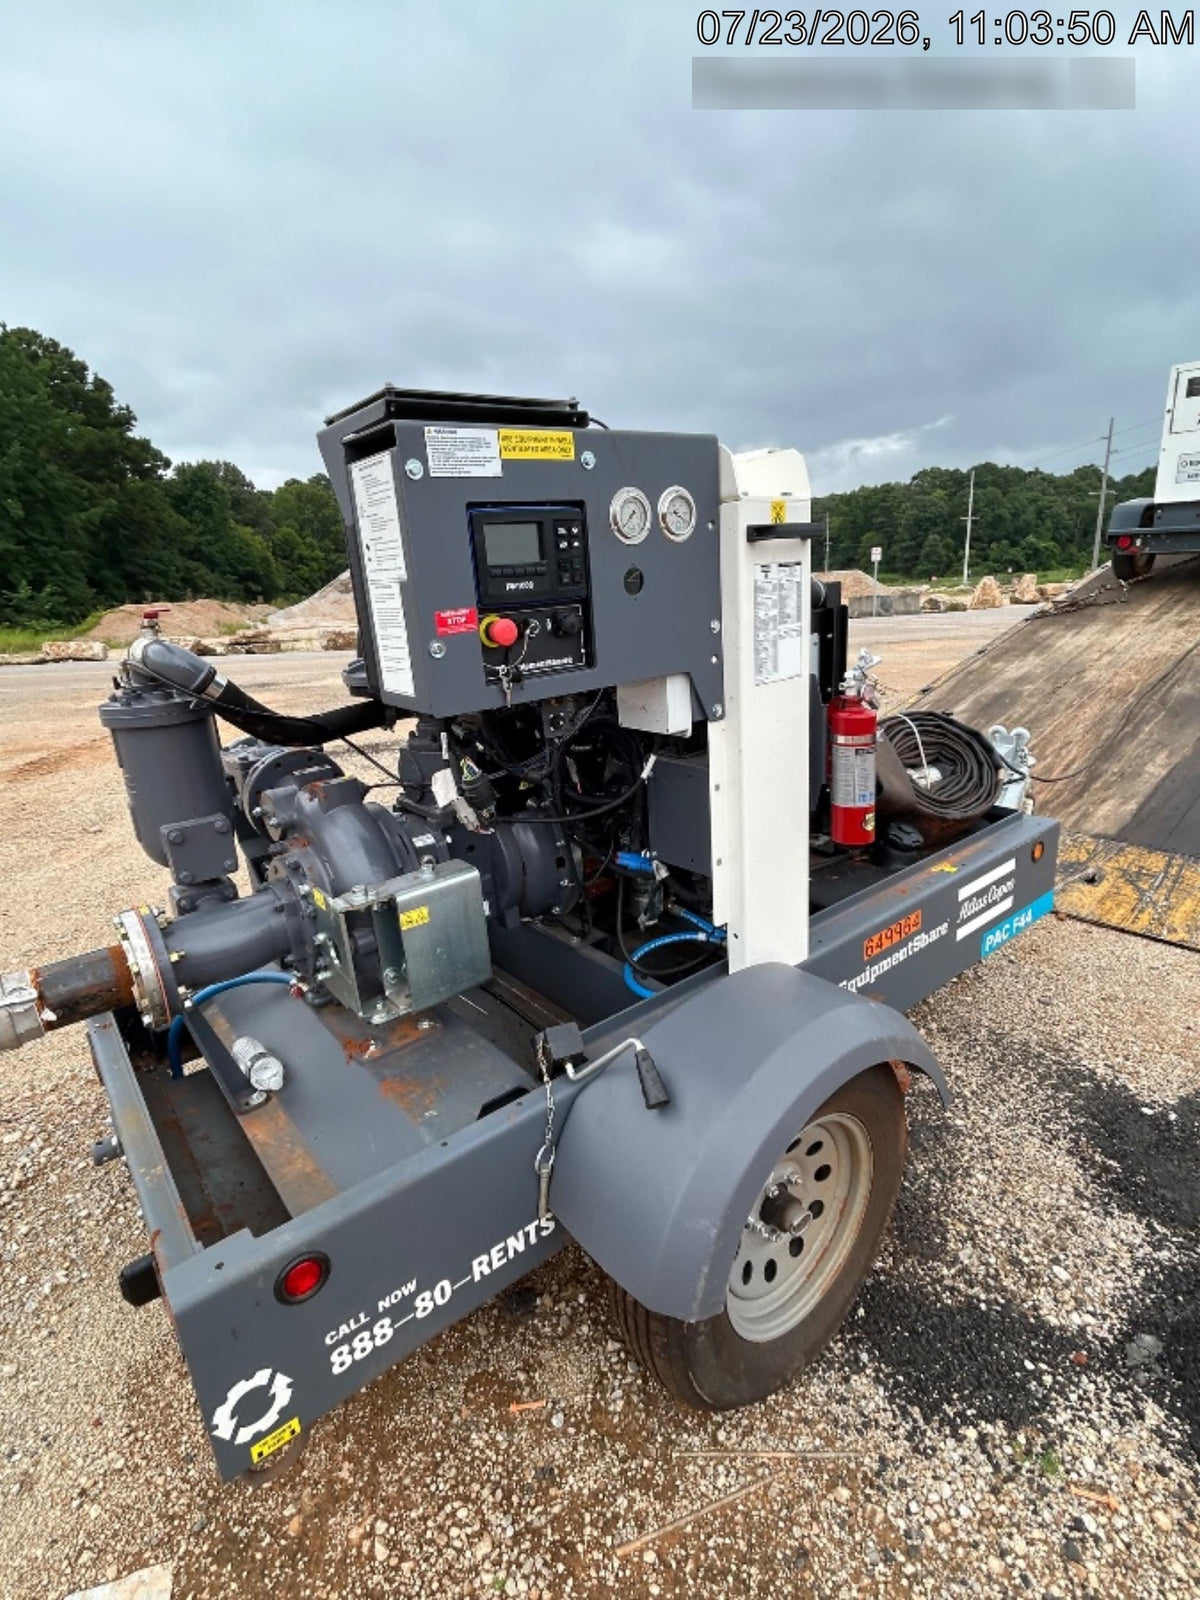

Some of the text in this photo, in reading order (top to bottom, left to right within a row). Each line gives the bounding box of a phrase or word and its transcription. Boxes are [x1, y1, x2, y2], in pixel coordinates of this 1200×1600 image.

[984, 924, 1011, 952] PAC
[324, 1278, 418, 1345] CALL NOW
